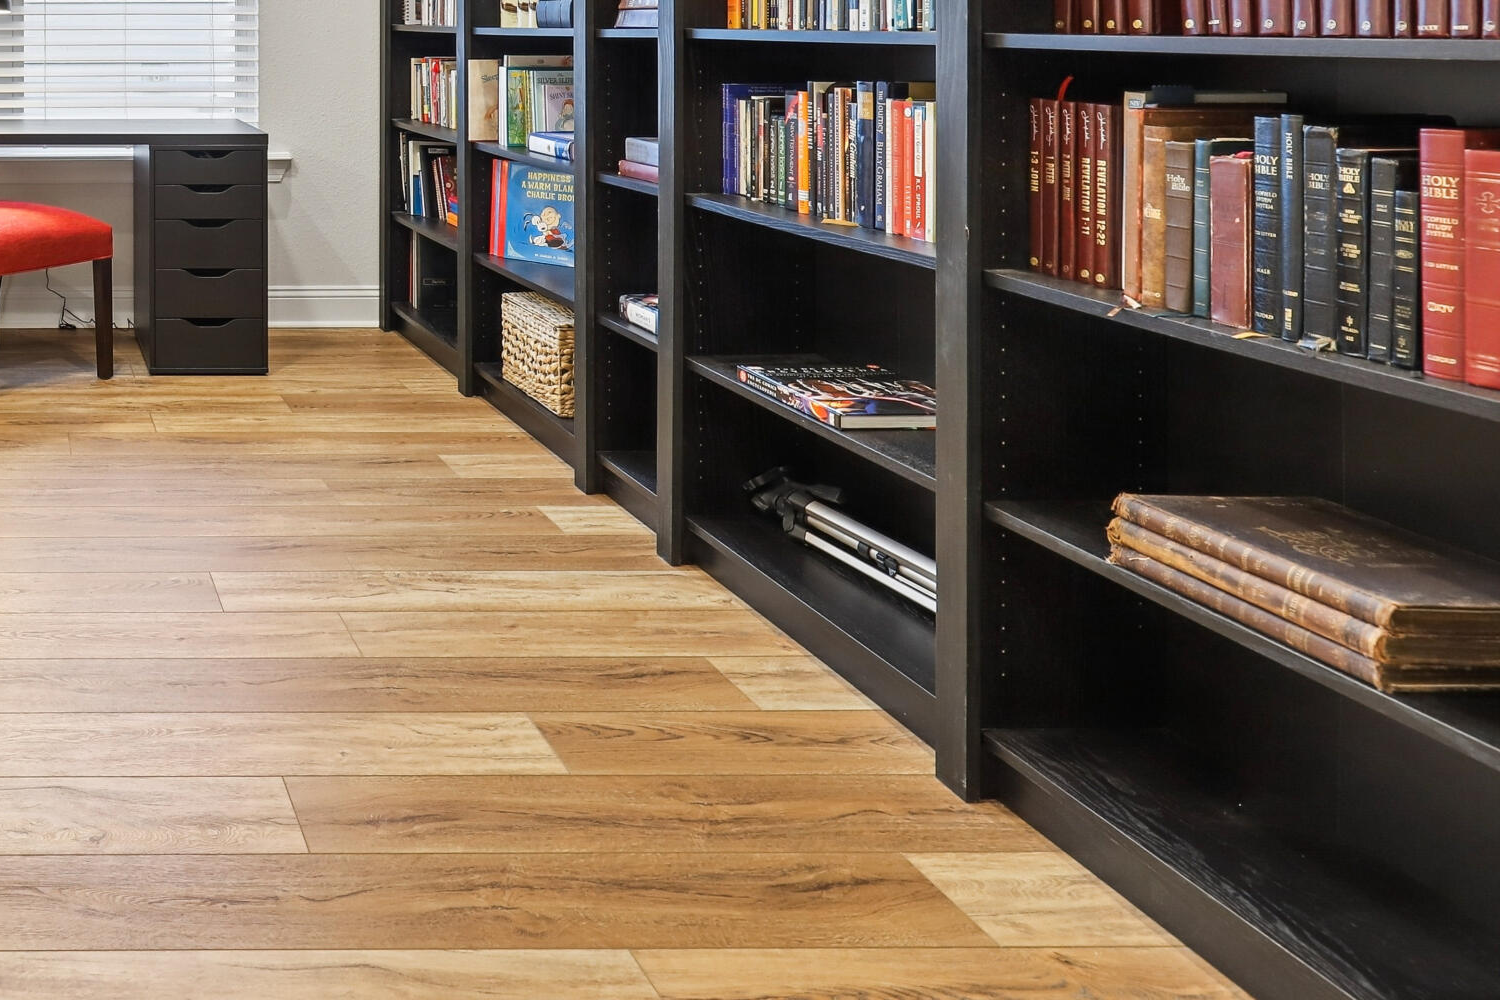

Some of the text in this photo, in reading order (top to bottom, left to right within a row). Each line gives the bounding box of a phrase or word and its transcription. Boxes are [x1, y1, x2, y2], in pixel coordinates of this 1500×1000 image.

[1285, 132, 1293, 154] HOLY
[875, 141, 884, 167] BILLY
[528, 171, 571, 183] HAPPINESS
[1030, 151, 1039, 192] 1-3 JOHN
[1045, 163, 1055, 185] PETER
[1339, 166, 1360, 176] HOLY
[528, 181, 551, 191] WARM
[875, 167, 884, 205] GRAHAM
[1166, 173, 1186, 185] Holy
[1338, 174, 1360, 184] BIBLE
[1421, 174, 1460, 188] HOLY
[1171, 182, 1191, 192] Bible
[1421, 186, 1459, 200] BIBLE
[526, 190, 556, 201] CHARLIE
[1081, 157, 1091, 236] REVELATION 1-11
[1096, 159, 1107, 247] REVELATION 12-22
